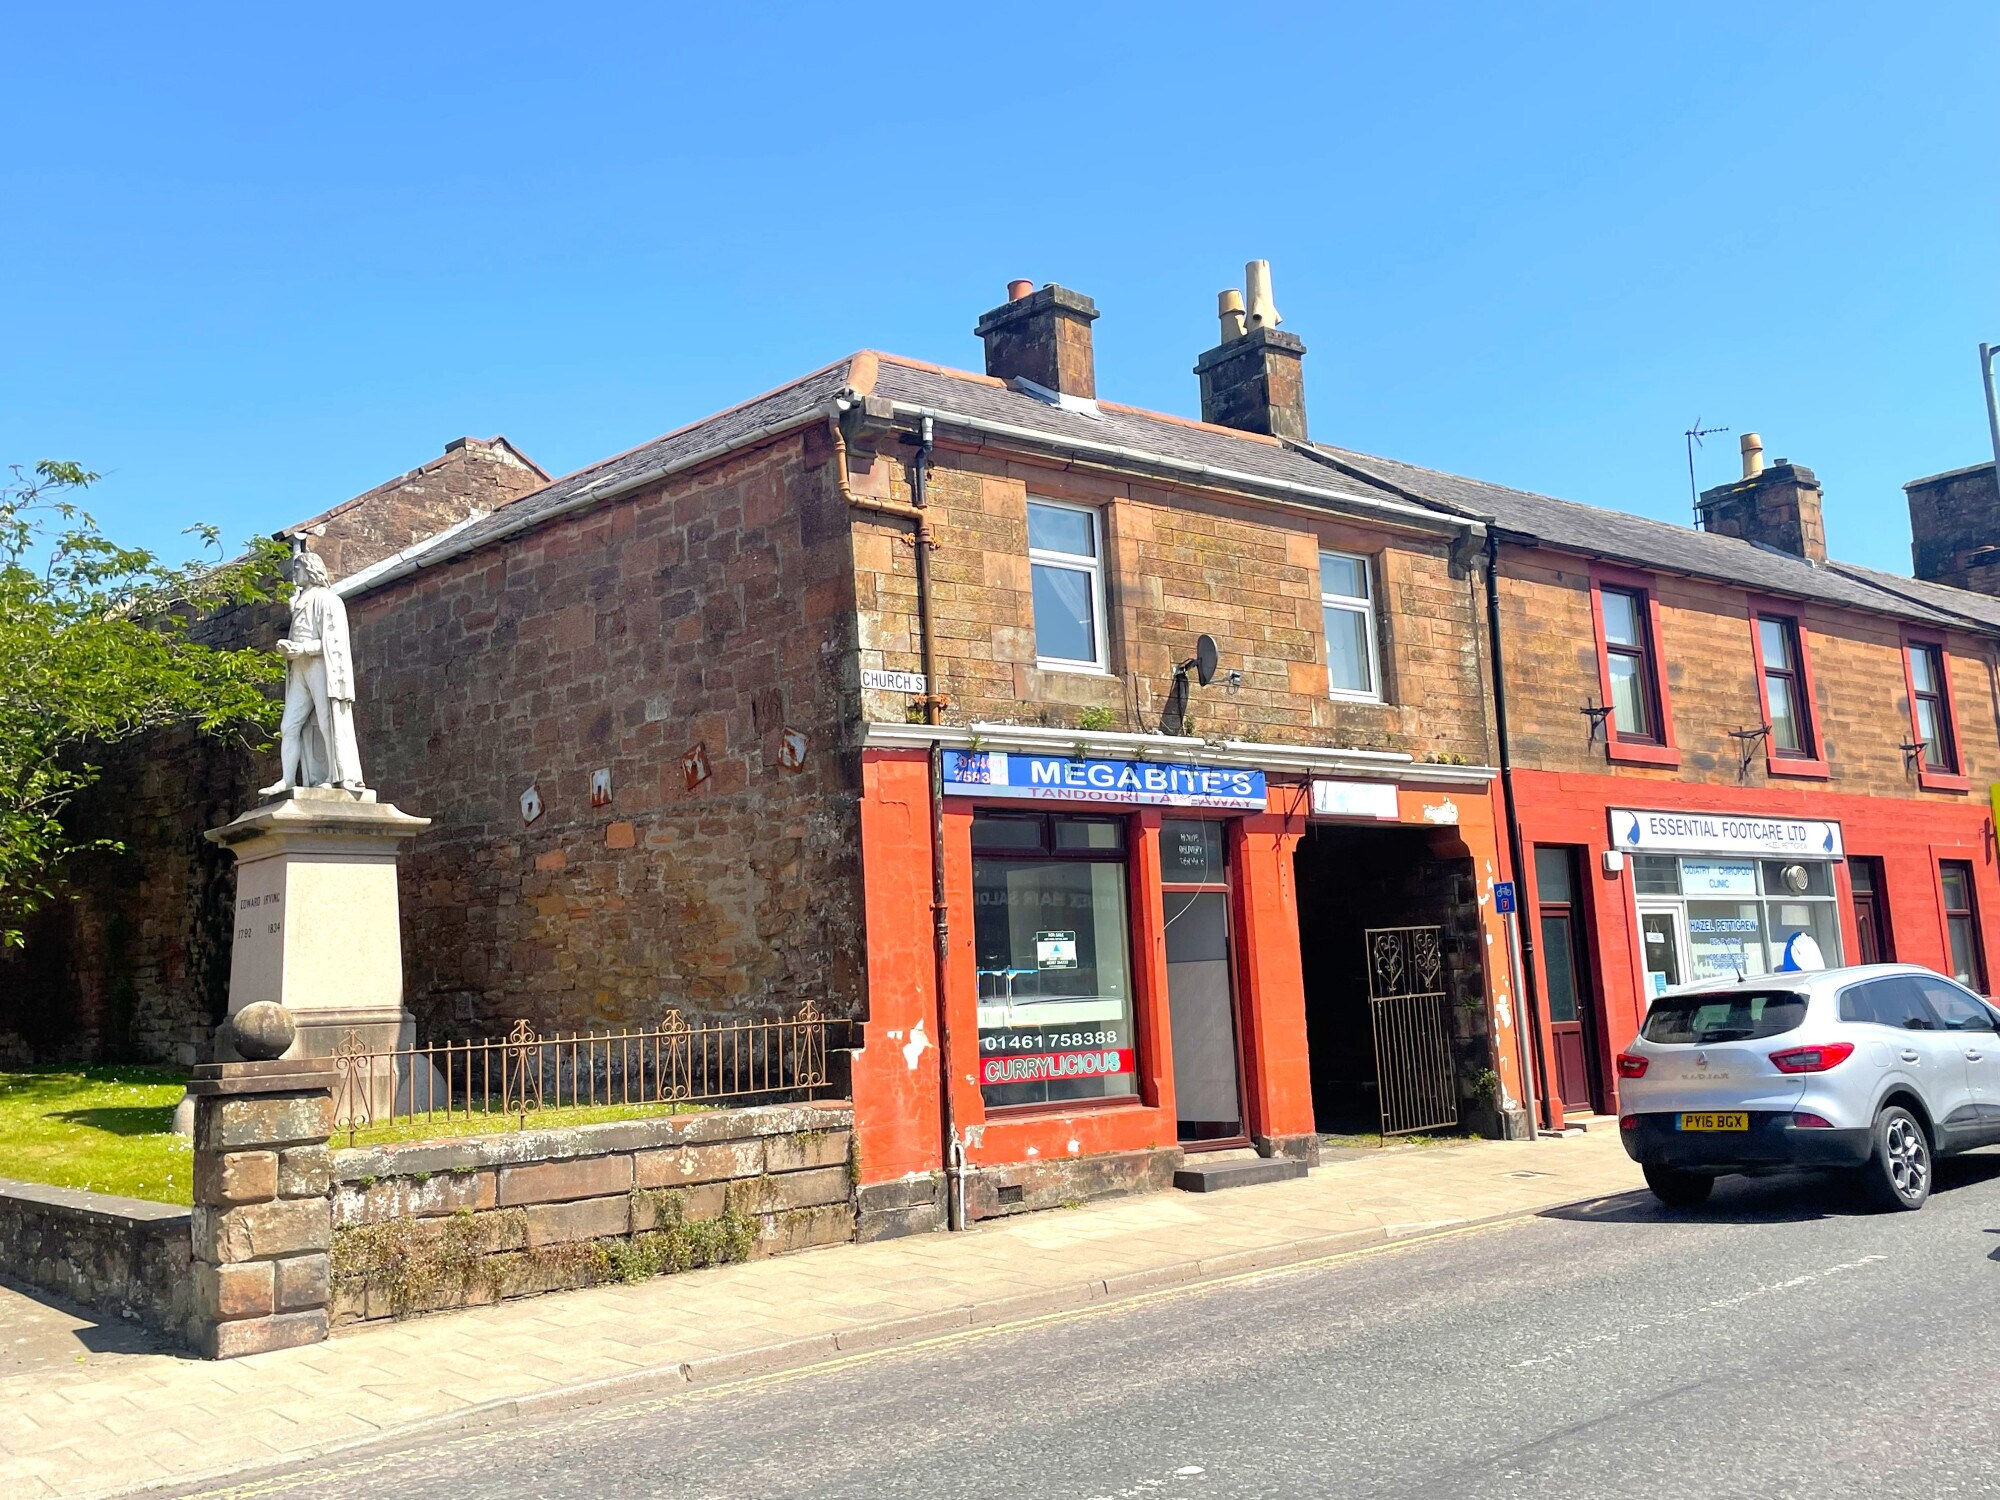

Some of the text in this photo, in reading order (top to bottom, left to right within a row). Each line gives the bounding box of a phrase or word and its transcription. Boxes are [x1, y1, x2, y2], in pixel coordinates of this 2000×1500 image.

[863, 671, 911, 690] CHURCH
[1031, 760, 1253, 795] MEGABITE'S
[1028, 787, 1139, 802] TANDOORI
[1650, 817, 1807, 842] ESSENTIAL FOOTCARE LTD
[1709, 879, 1730, 888] CLINIC
[240, 896, 260, 910] EDWARD
[1503, 900, 1508, 908] 7
[238, 922, 280, 939] 1792 1834
[1690, 920, 1757, 932] HAZEL PETTIGREW
[985, 1030, 1118, 1050] 01461 758388
[985, 1052, 1121, 1082] CURRYLICIOUS
[1685, 1115, 1743, 1128] PY16 BGX
